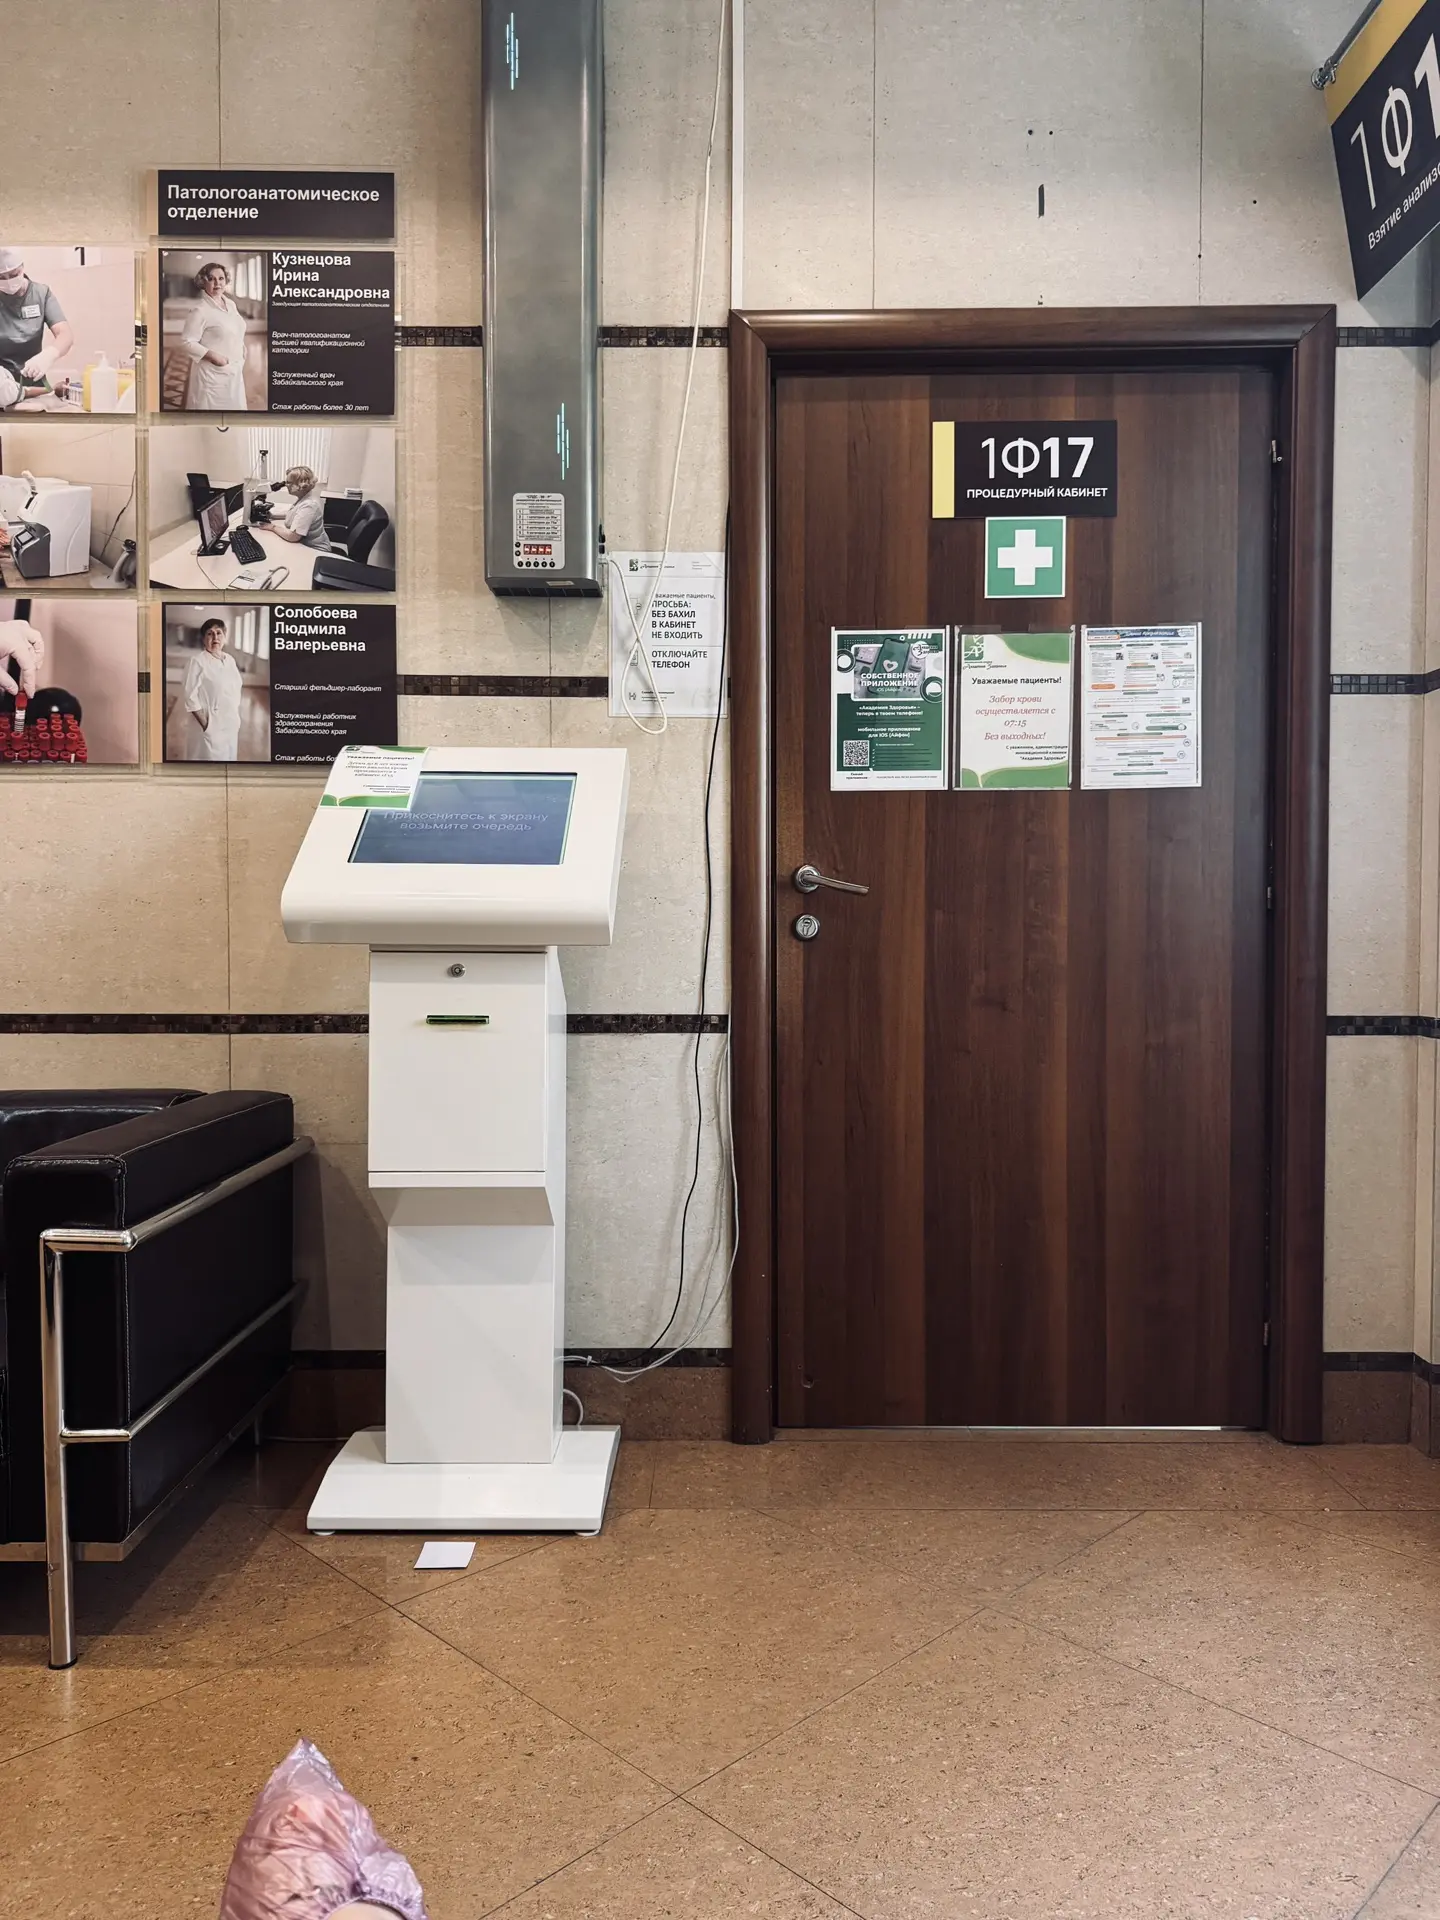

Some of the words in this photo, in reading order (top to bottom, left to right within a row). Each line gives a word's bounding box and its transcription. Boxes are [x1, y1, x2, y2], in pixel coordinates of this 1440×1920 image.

[167, 184, 380, 202] Патологоанатомическое
[167, 206, 259, 220] отделение
[1368, 207, 1402, 250] Взятие
[272, 252, 351, 267] Кузнецова
[272, 268, 320, 284] Ирина
[272, 284, 390, 300] Александровна
[272, 331, 351, 340] Врач-патологоанатом
[272, 371, 319, 379] Заслуженный
[293, 403, 322, 411] работы
[322, 403, 344, 411] более
[981, 436, 1094, 479] 1Ф17
[966, 485, 1055, 499] ПРОЦЕДУРНЫЙ
[1057, 487, 1108, 498] КАБИНЕТ
[651, 600, 692, 608] ПРОСЬБА:
[274, 605, 358, 619] Солобоева
[651, 610, 666, 618] БЕЗ
[668, 610, 696, 618] БАХИЛ
[274, 621, 347, 636] Людмила
[651, 620, 657, 628] В
[659, 620, 696, 628] КАБИНЕТ
[664, 631, 703, 640] ВХОДИТЬ
[274, 637, 366, 653] Валерьевна
[651, 650, 708, 658] ОТКЛЮЧАЙТЕ
[651, 660, 690, 668] ТЕЛЕФОН
[971, 677, 1018, 685] Уважаемые
[1020, 676, 1062, 685] пациенты!
[274, 683, 308, 691] Старший
[309, 684, 382, 692] фельдшер-лаборант
[989, 695, 1015, 704] Забор
[1016, 696, 1042, 704] крови
[275, 712, 322, 720] Заслуженный
[322, 712, 357, 720] работник
[975, 708, 1049, 716] осуществляется
[275, 720, 334, 728] здравоохранения
[275, 727, 330, 735] Забайкальского
[330, 728, 347, 736] края
[984, 732, 999, 740] Без
[1000, 731, 1047, 740] выходных!
[296, 755, 325, 763] работы
[384, 811, 484, 821] Прикоснитесь
[500, 813, 549, 822] экрану
[400, 822, 469, 830] возьмите
[472, 823, 533, 832] очередь
